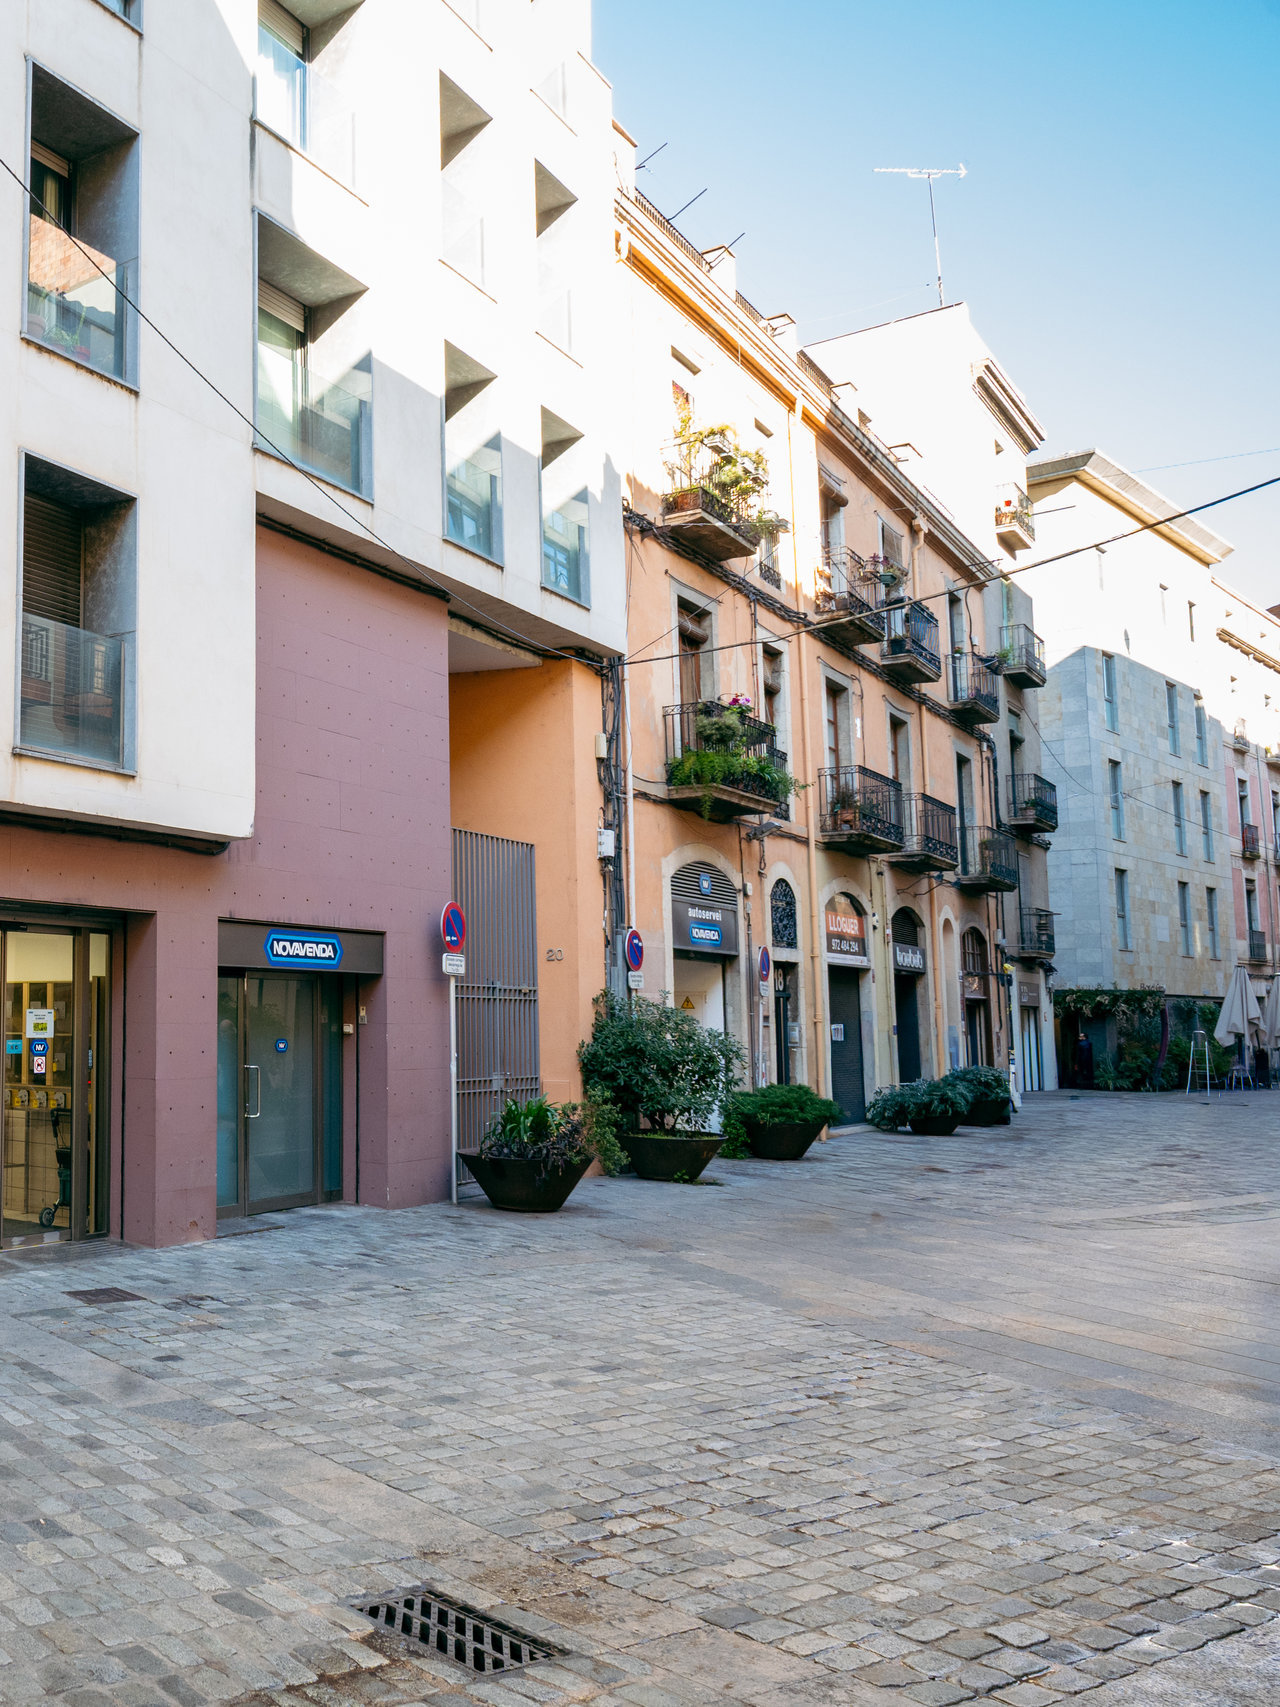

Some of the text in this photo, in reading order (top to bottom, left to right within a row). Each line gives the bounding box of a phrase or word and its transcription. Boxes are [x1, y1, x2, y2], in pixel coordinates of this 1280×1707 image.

[688, 907, 722, 921] autoservei
[828, 914, 859, 935] LLOGUER
[692, 927, 719, 940] NOVAVENDA
[273, 940, 335, 958] NOVAVENDA
[546, 948, 564, 961] 20
[774, 968, 784, 991] 18
